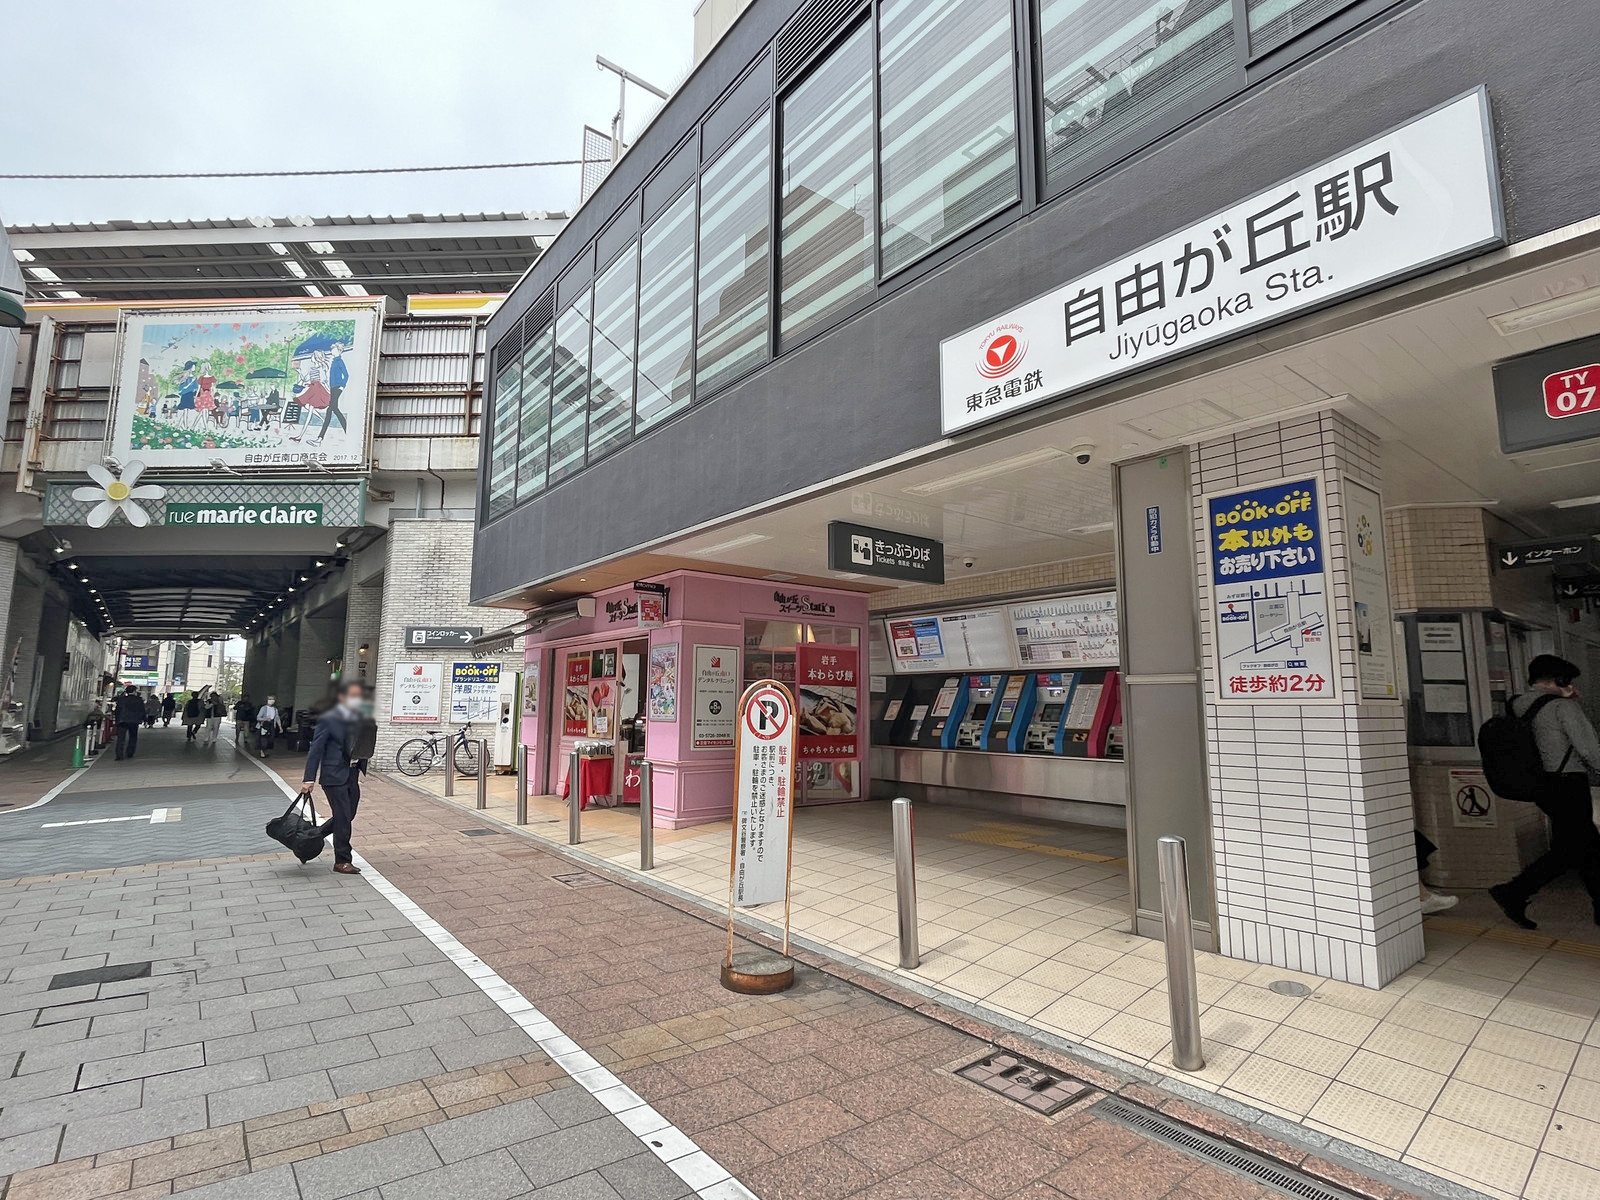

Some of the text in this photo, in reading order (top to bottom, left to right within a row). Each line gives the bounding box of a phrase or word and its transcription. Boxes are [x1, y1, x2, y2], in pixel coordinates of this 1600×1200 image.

[1063, 151, 1400, 347] 自由が丘駅
[1108, 265, 1334, 361] Jiyūgaoka Sta.
[979, 323, 1024, 350] TOKYU RAILWAYS
[1560, 371, 1589, 388] TY
[966, 369, 1044, 414] 東急電鉄
[1556, 386, 1597, 412] 07
[244, 452, 328, 463] 自由が丘南口商店会
[170, 505, 318, 524] rue marie claire
[1218, 522, 1314, 552] 本以外も
[874, 540, 930, 562] きっぷうりば
[875, 554, 896, 565] Tickets
[1220, 546, 1316, 576] お売り下さい
[1525, 546, 1582, 558] インターホン
[821, 655, 838, 666] 岩手
[454, 684, 472, 694] 洋服
[1229, 674, 1326, 694] 徒歩約2分
[776, 746, 788, 818] 駐車・駐輪禁止
